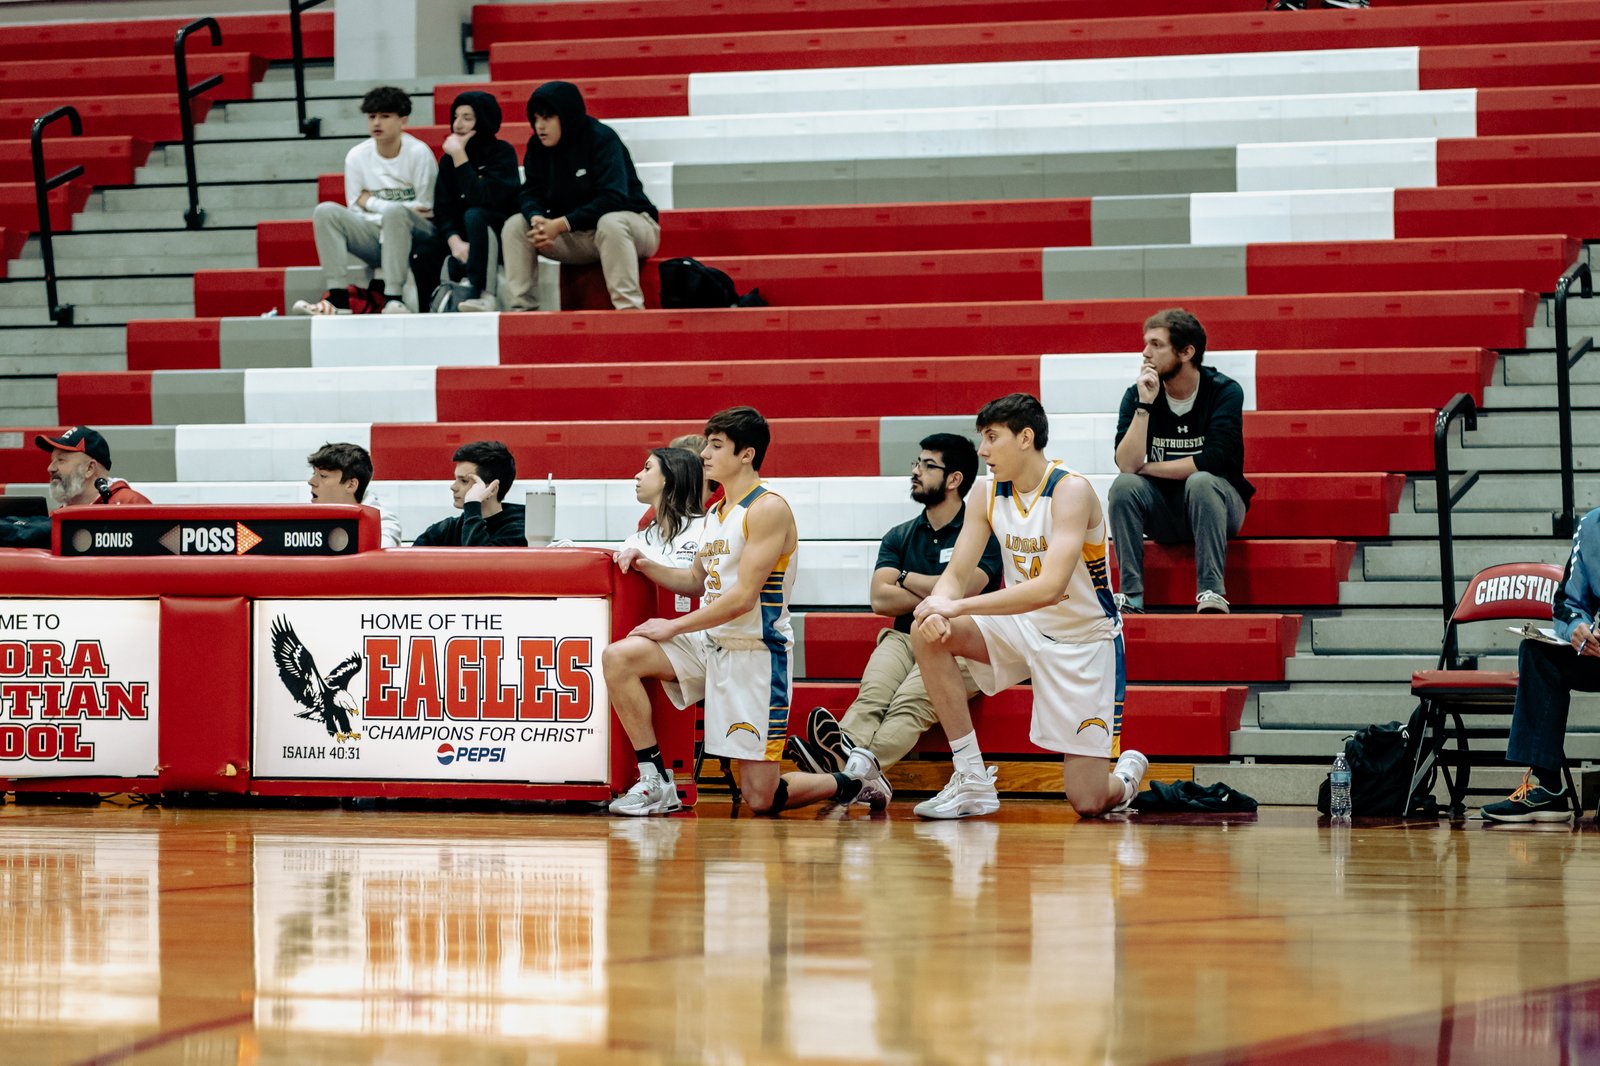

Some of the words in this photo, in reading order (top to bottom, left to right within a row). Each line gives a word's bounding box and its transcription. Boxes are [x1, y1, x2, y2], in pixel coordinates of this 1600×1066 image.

[1152, 436, 1205, 449] NORTHWEST
[95, 532, 133, 548] BONUS
[182, 527, 235, 552] POSS
[284, 531, 323, 547] BONUS
[33, 613, 60, 630] TO
[361, 613, 423, 630] HOME
[428, 613, 456, 630] OF
[461, 614, 503, 630] THE
[0, 639, 110, 678] ORA
[362, 635, 594, 723] EAGLES
[0, 681, 149, 720] TIAN
[0, 723, 95, 761] OOL
[362, 725, 474, 742] "CHAMPIONS
[479, 726, 515, 742] FOR
[520, 727, 594, 743] CHRIST"
[282, 746, 326, 760] ISAIAH
[329, 746, 361, 760] 40:31
[455, 746, 506, 762] PEPSI
